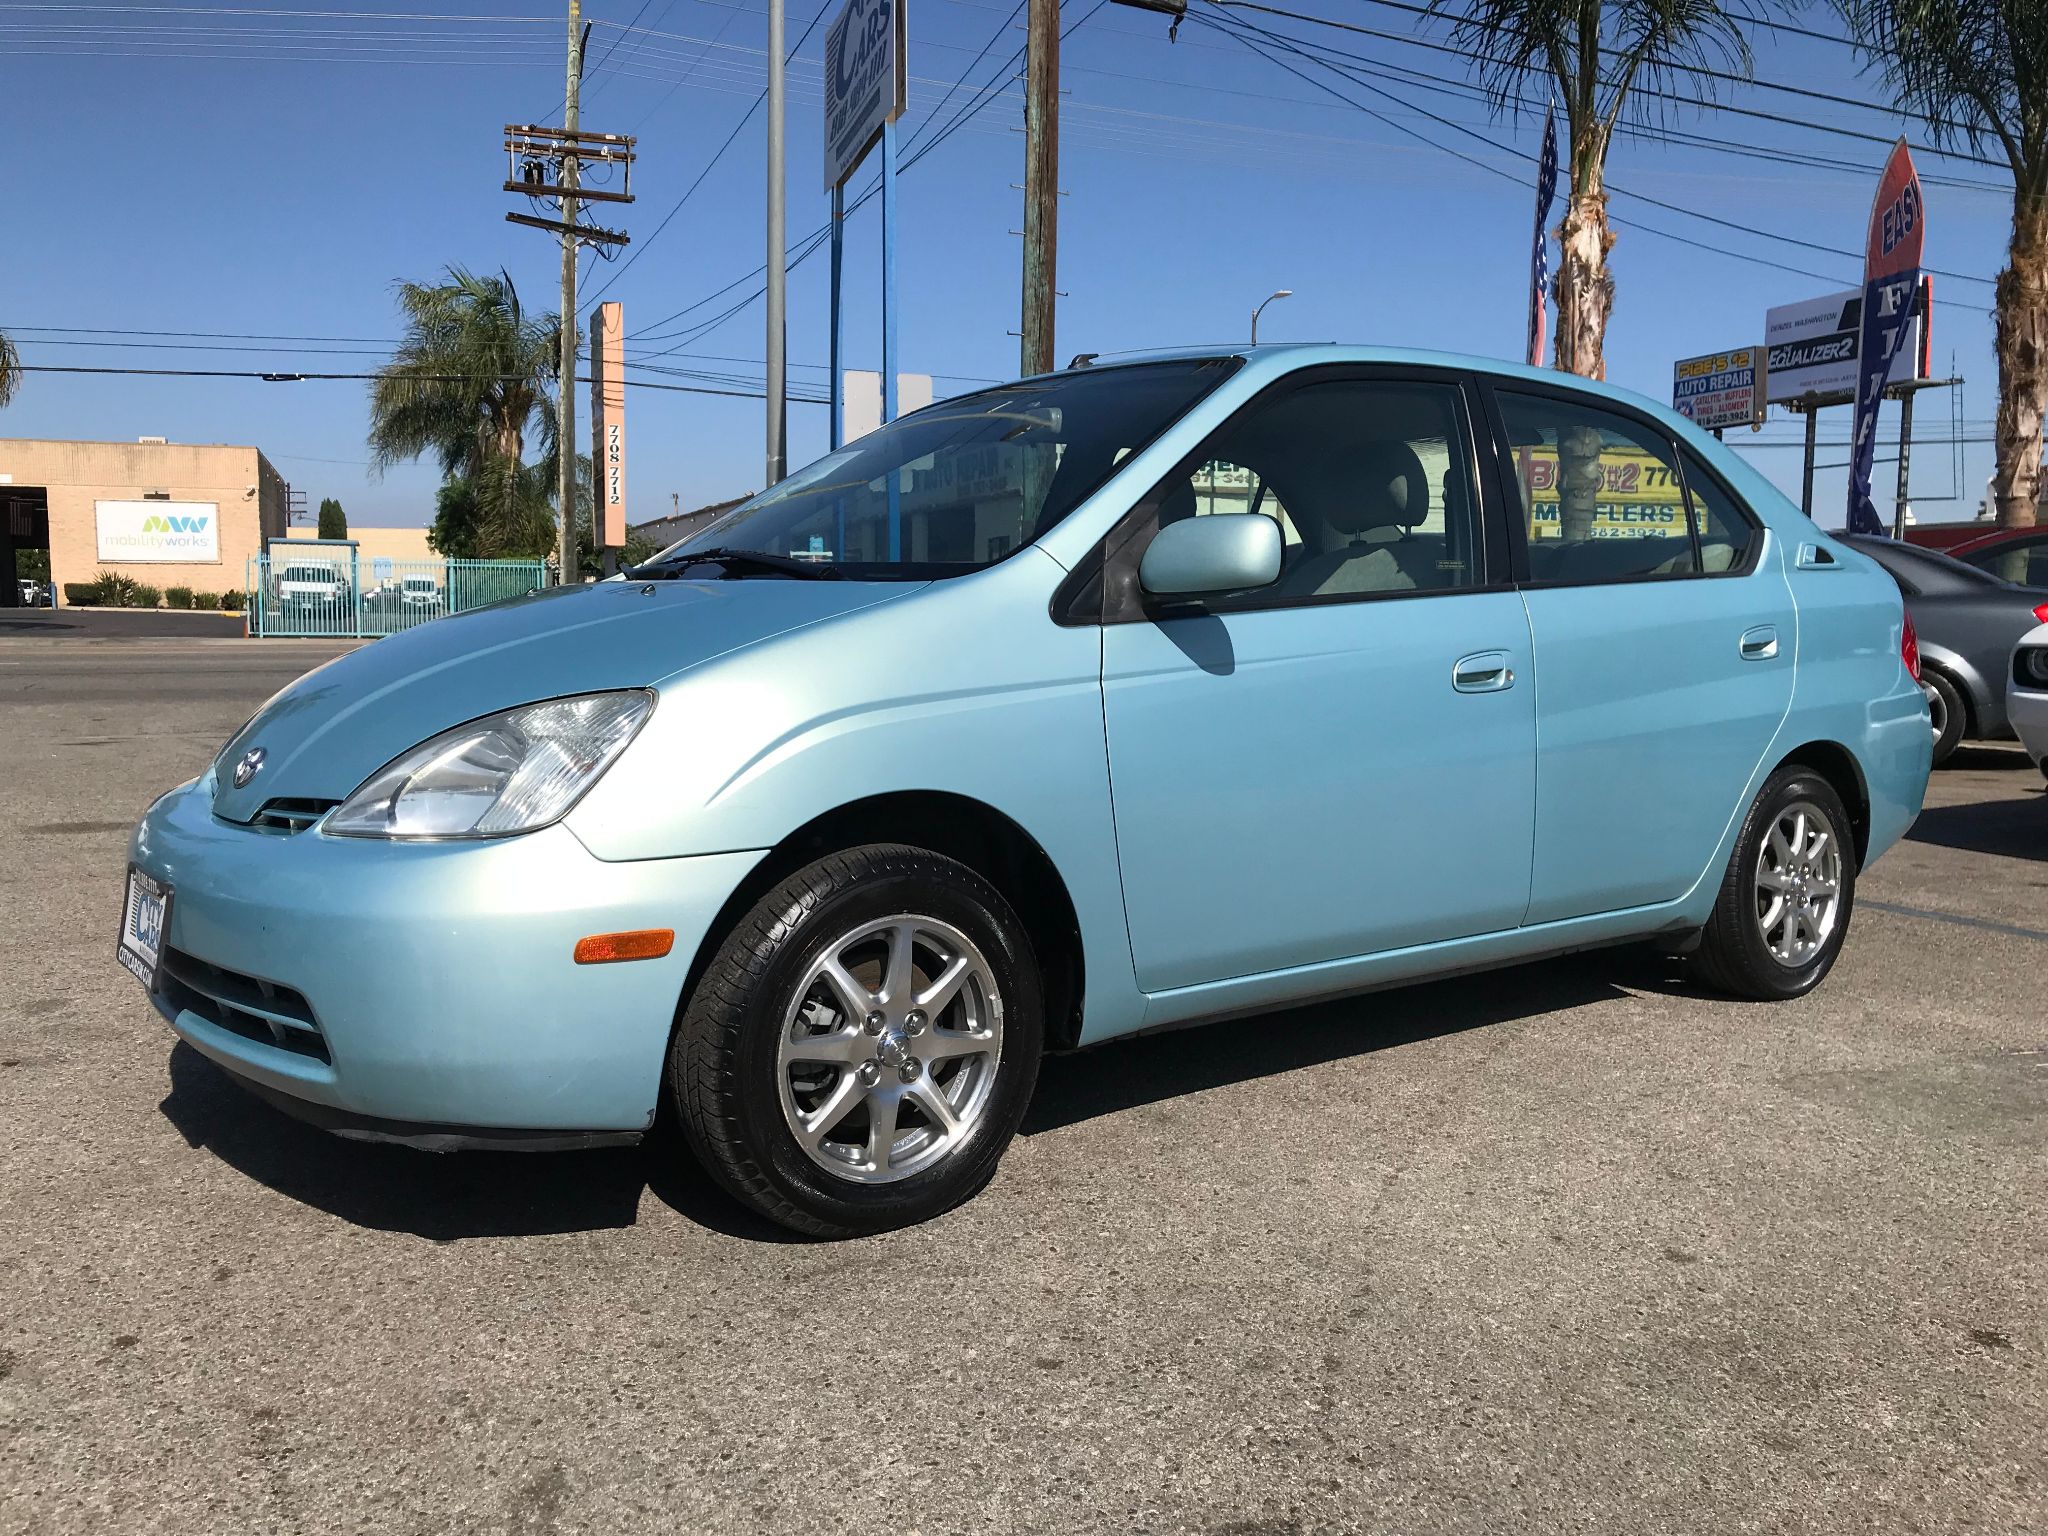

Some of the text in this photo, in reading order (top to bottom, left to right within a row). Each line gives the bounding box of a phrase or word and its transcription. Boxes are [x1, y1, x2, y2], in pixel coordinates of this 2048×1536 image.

[1882, 177, 1921, 258] EASY
[1770, 312, 1838, 332] DENZEL WASHINGTON
[1677, 370, 1752, 397] AUTO REPAIR
[1696, 392, 1721, 406] CATALYTIC
[1697, 404, 1713, 416] TIRES
[609, 425, 620, 463] 7708
[609, 466, 620, 505] 7712
[1534, 503, 1675, 523] MFLERS
[104, 534, 208, 549] mobilityworks
